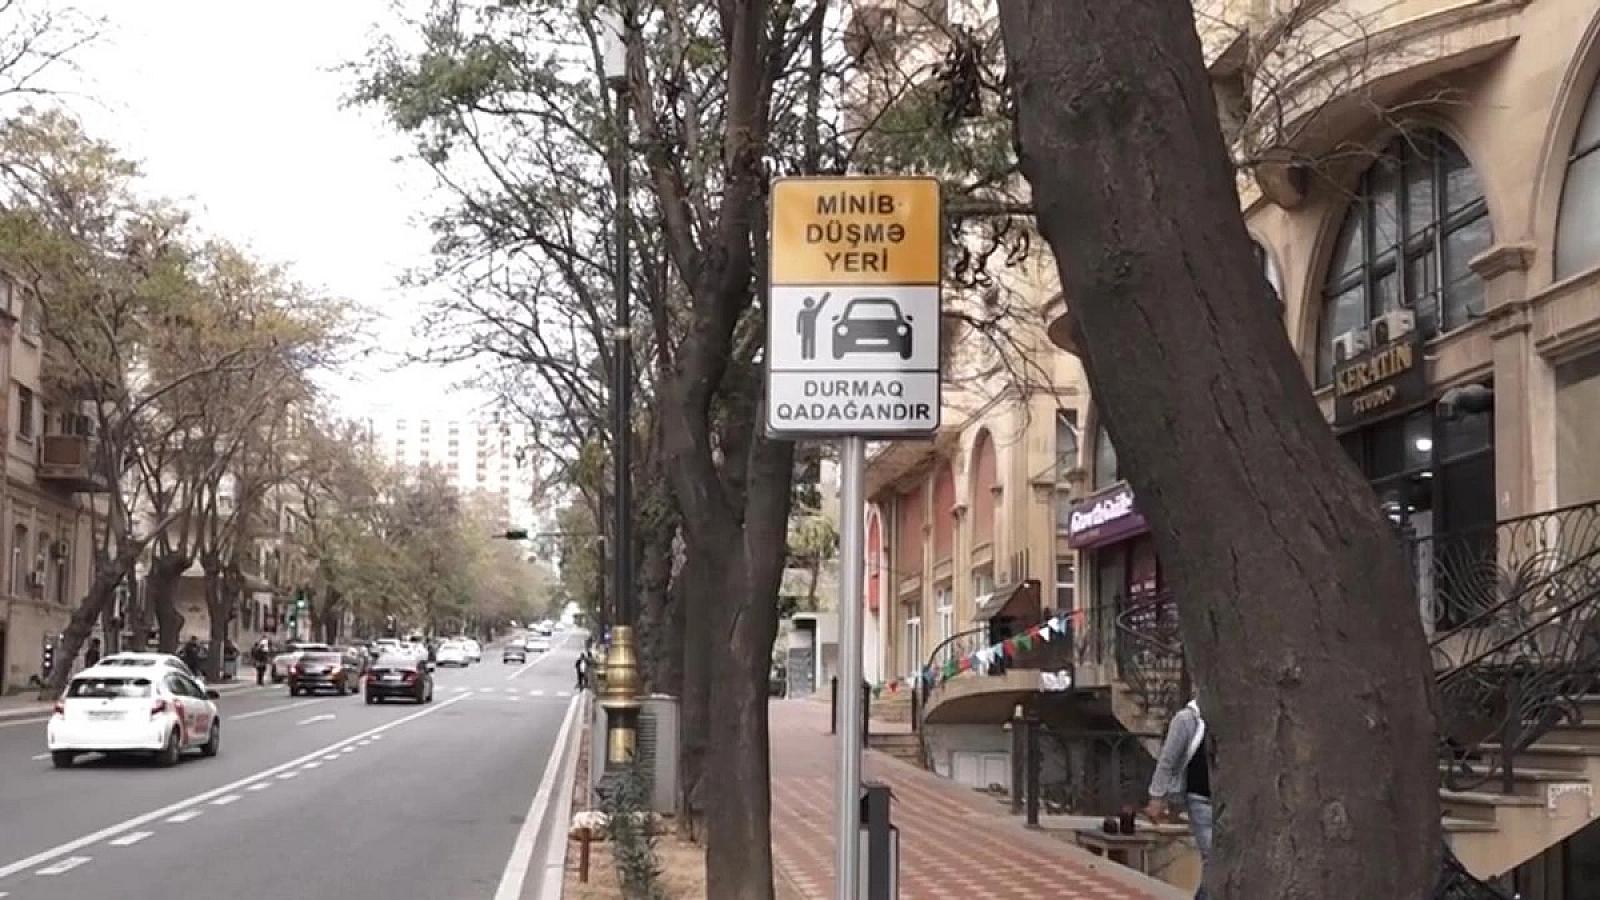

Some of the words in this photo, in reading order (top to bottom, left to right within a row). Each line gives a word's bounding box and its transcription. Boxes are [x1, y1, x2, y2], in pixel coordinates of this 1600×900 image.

[816, 192, 895, 215] MİNİB
[806, 220, 905, 247] DÜŞMƏ
[824, 248, 888, 272] YERİ
[804, 380, 904, 397] DURMAQ
[776, 400, 930, 420] QADAĞANDIR
